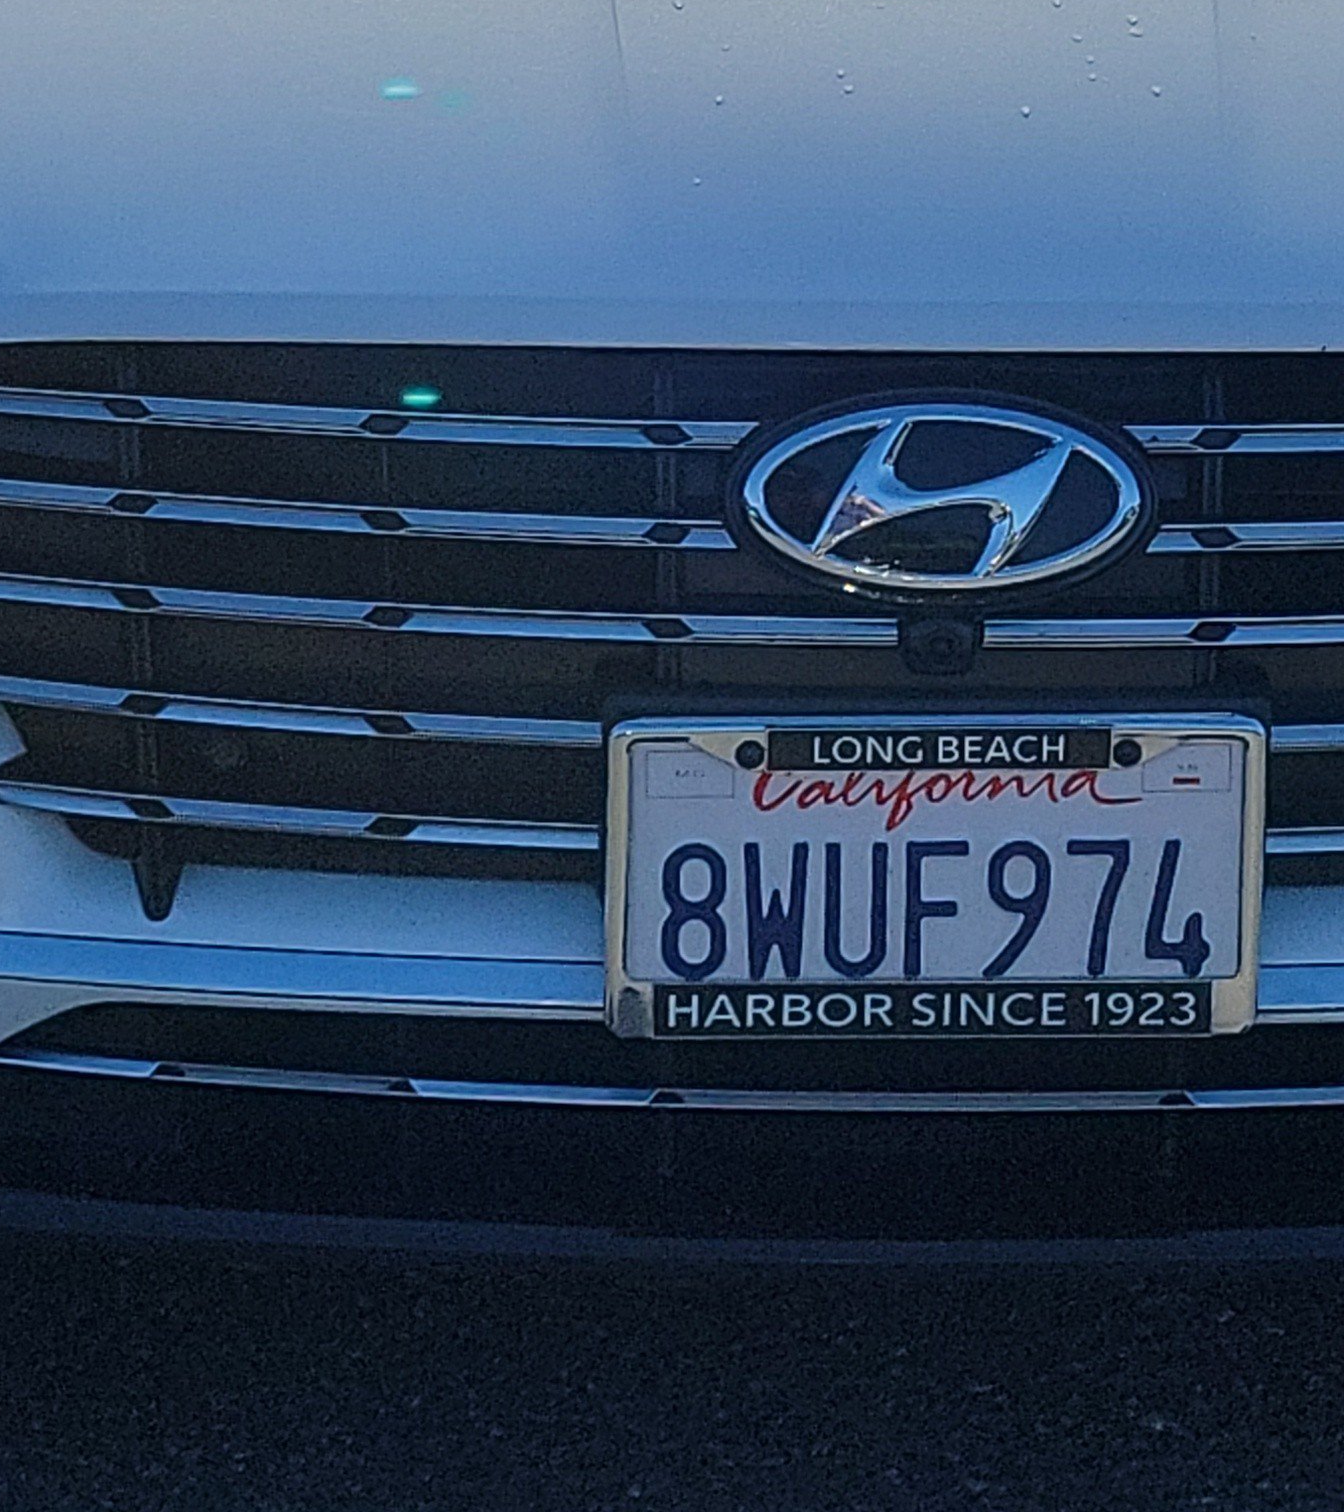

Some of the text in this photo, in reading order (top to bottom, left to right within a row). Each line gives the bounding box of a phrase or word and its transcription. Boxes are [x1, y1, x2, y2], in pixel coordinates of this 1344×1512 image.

[812, 734, 1066, 765] LONG BEACH
[660, 838, 1212, 979] 8WUF974
[667, 990, 1198, 1029] HARBOR SINCE 1923
